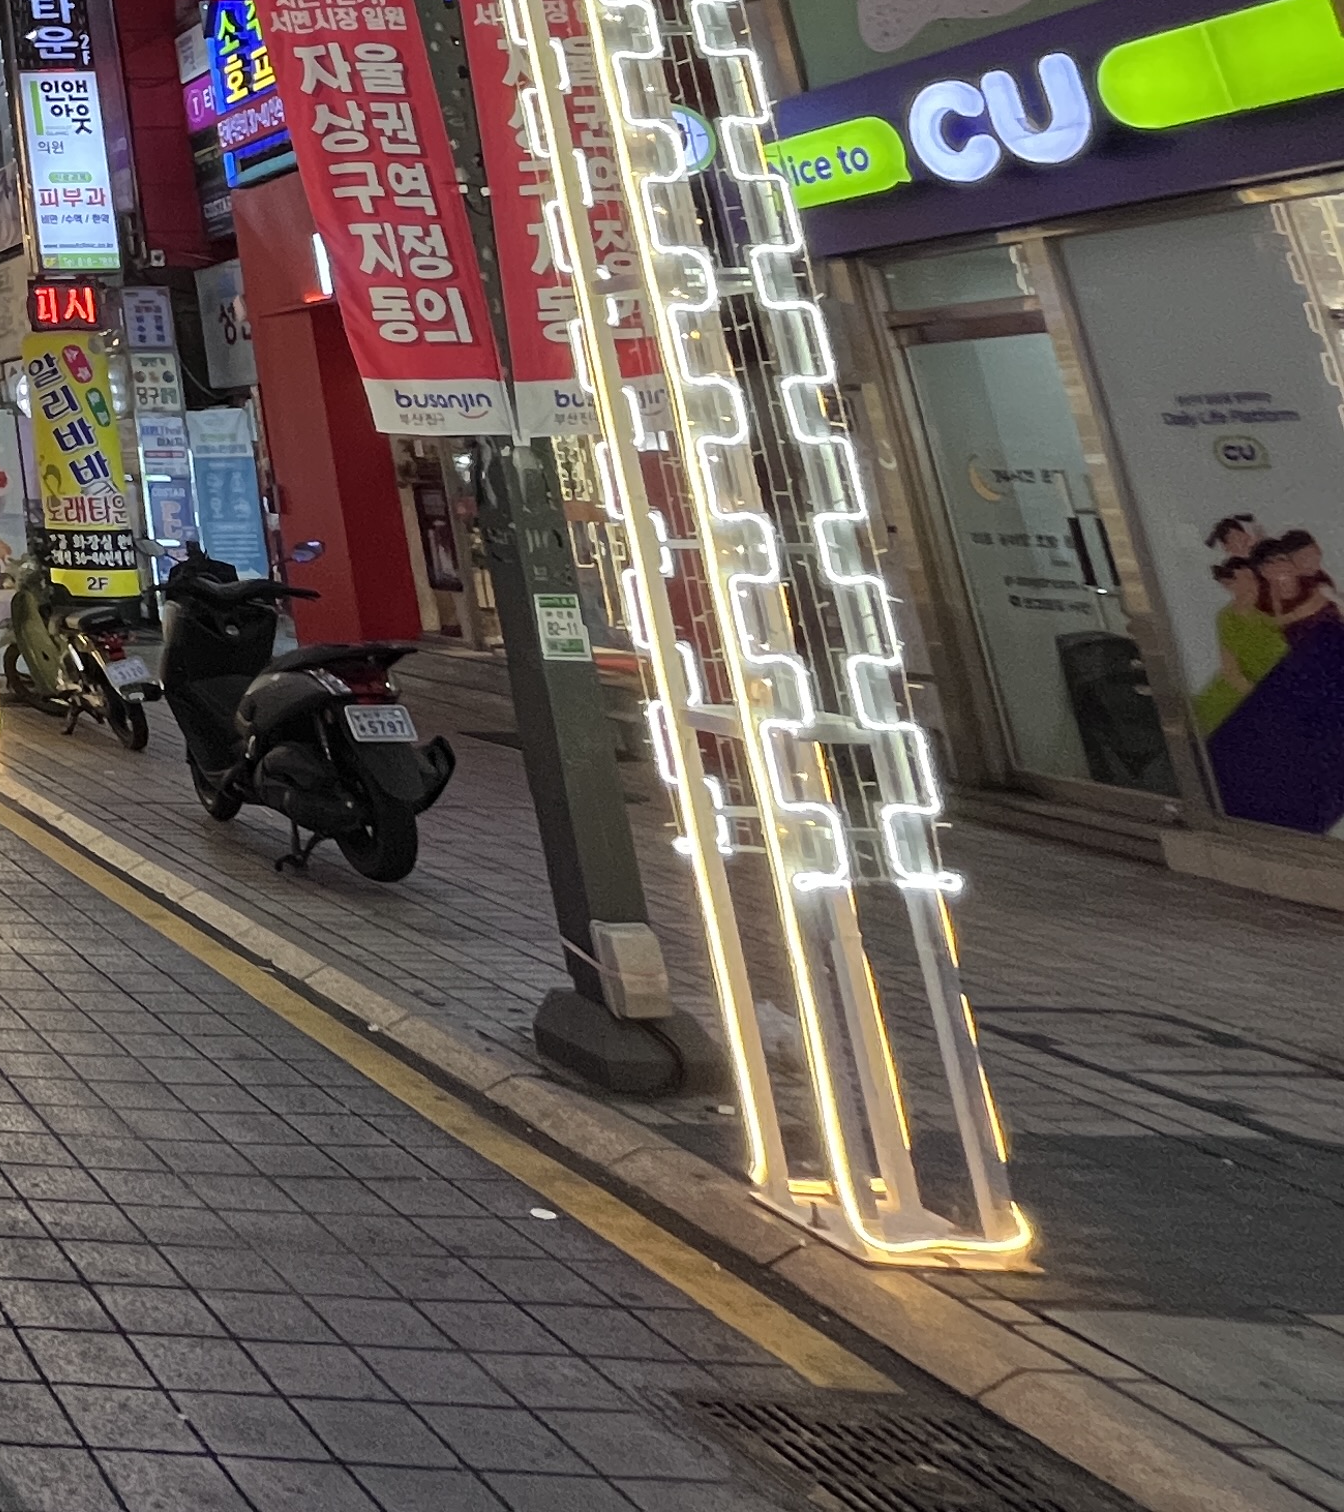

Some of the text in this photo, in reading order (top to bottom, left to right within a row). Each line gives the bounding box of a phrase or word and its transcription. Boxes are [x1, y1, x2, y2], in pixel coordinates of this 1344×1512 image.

[270, 6, 407, 34] 서면시장 일원
[225, 45, 277, 104] 호프
[294, 42, 408, 95] 자율
[39, 79, 90, 103] 인앤
[49, 103, 94, 136] 아웃
[311, 100, 422, 155] 상권
[909, 51, 1093, 184] CU
[36, 140, 65, 156] 의원
[835, 142, 871, 176] to
[37, 187, 107, 208] 피부과
[328, 161, 437, 217] 구역
[347, 222, 454, 279] 지정
[368, 287, 473, 344] 동의
[394, 389, 493, 415] busanjin
[27, 352, 110, 488] 알리바바
[46, 495, 128, 525] 노래타운
[86, 576, 110, 591] 2F
[368, 719, 407, 735] 5797
